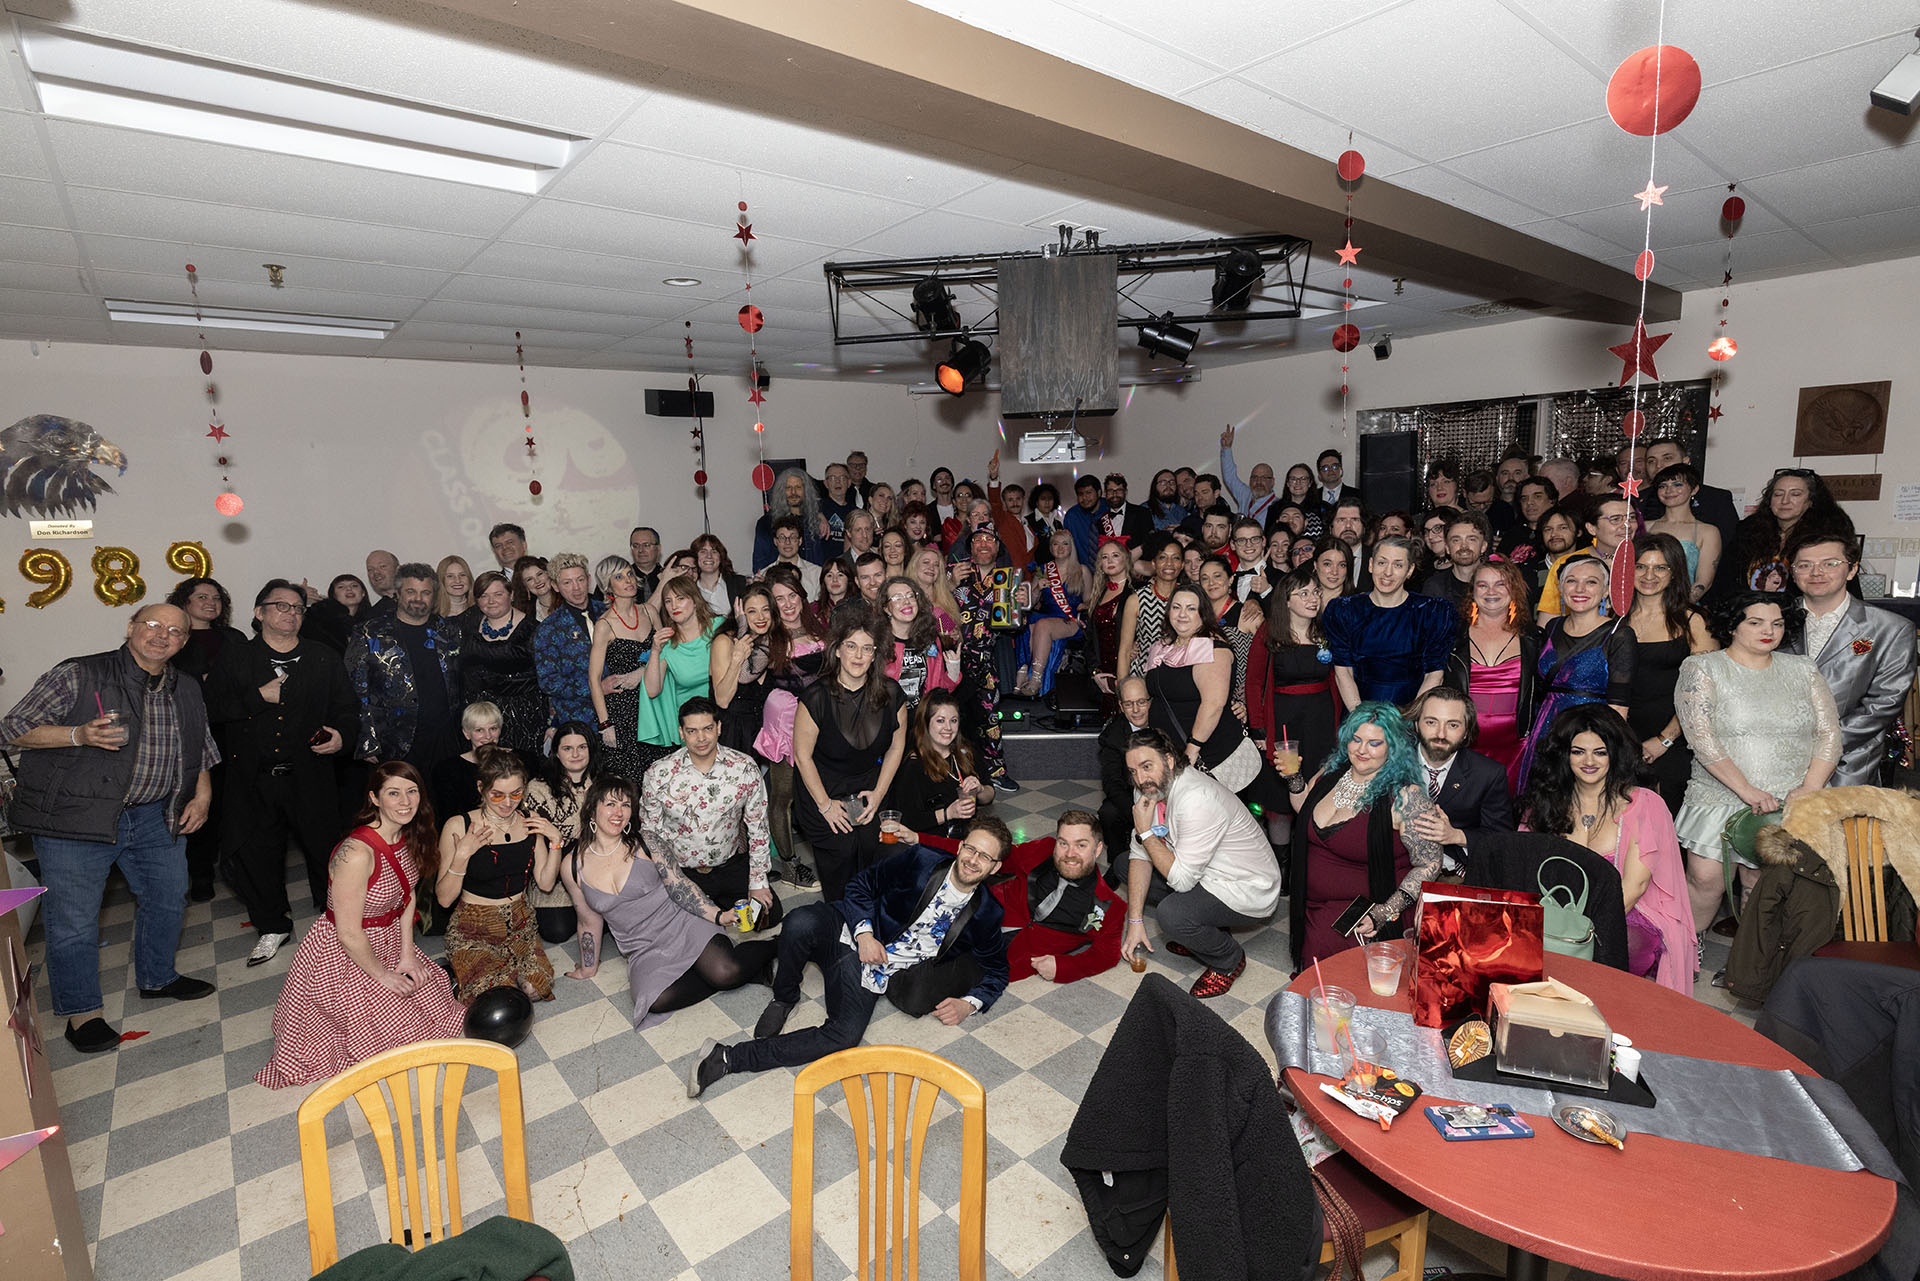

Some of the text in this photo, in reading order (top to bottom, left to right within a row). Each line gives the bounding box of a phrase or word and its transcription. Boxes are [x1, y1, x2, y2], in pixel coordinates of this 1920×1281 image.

[0, 541, 213, 614] 989
[1047, 561, 1072, 613] OM QUEEN
